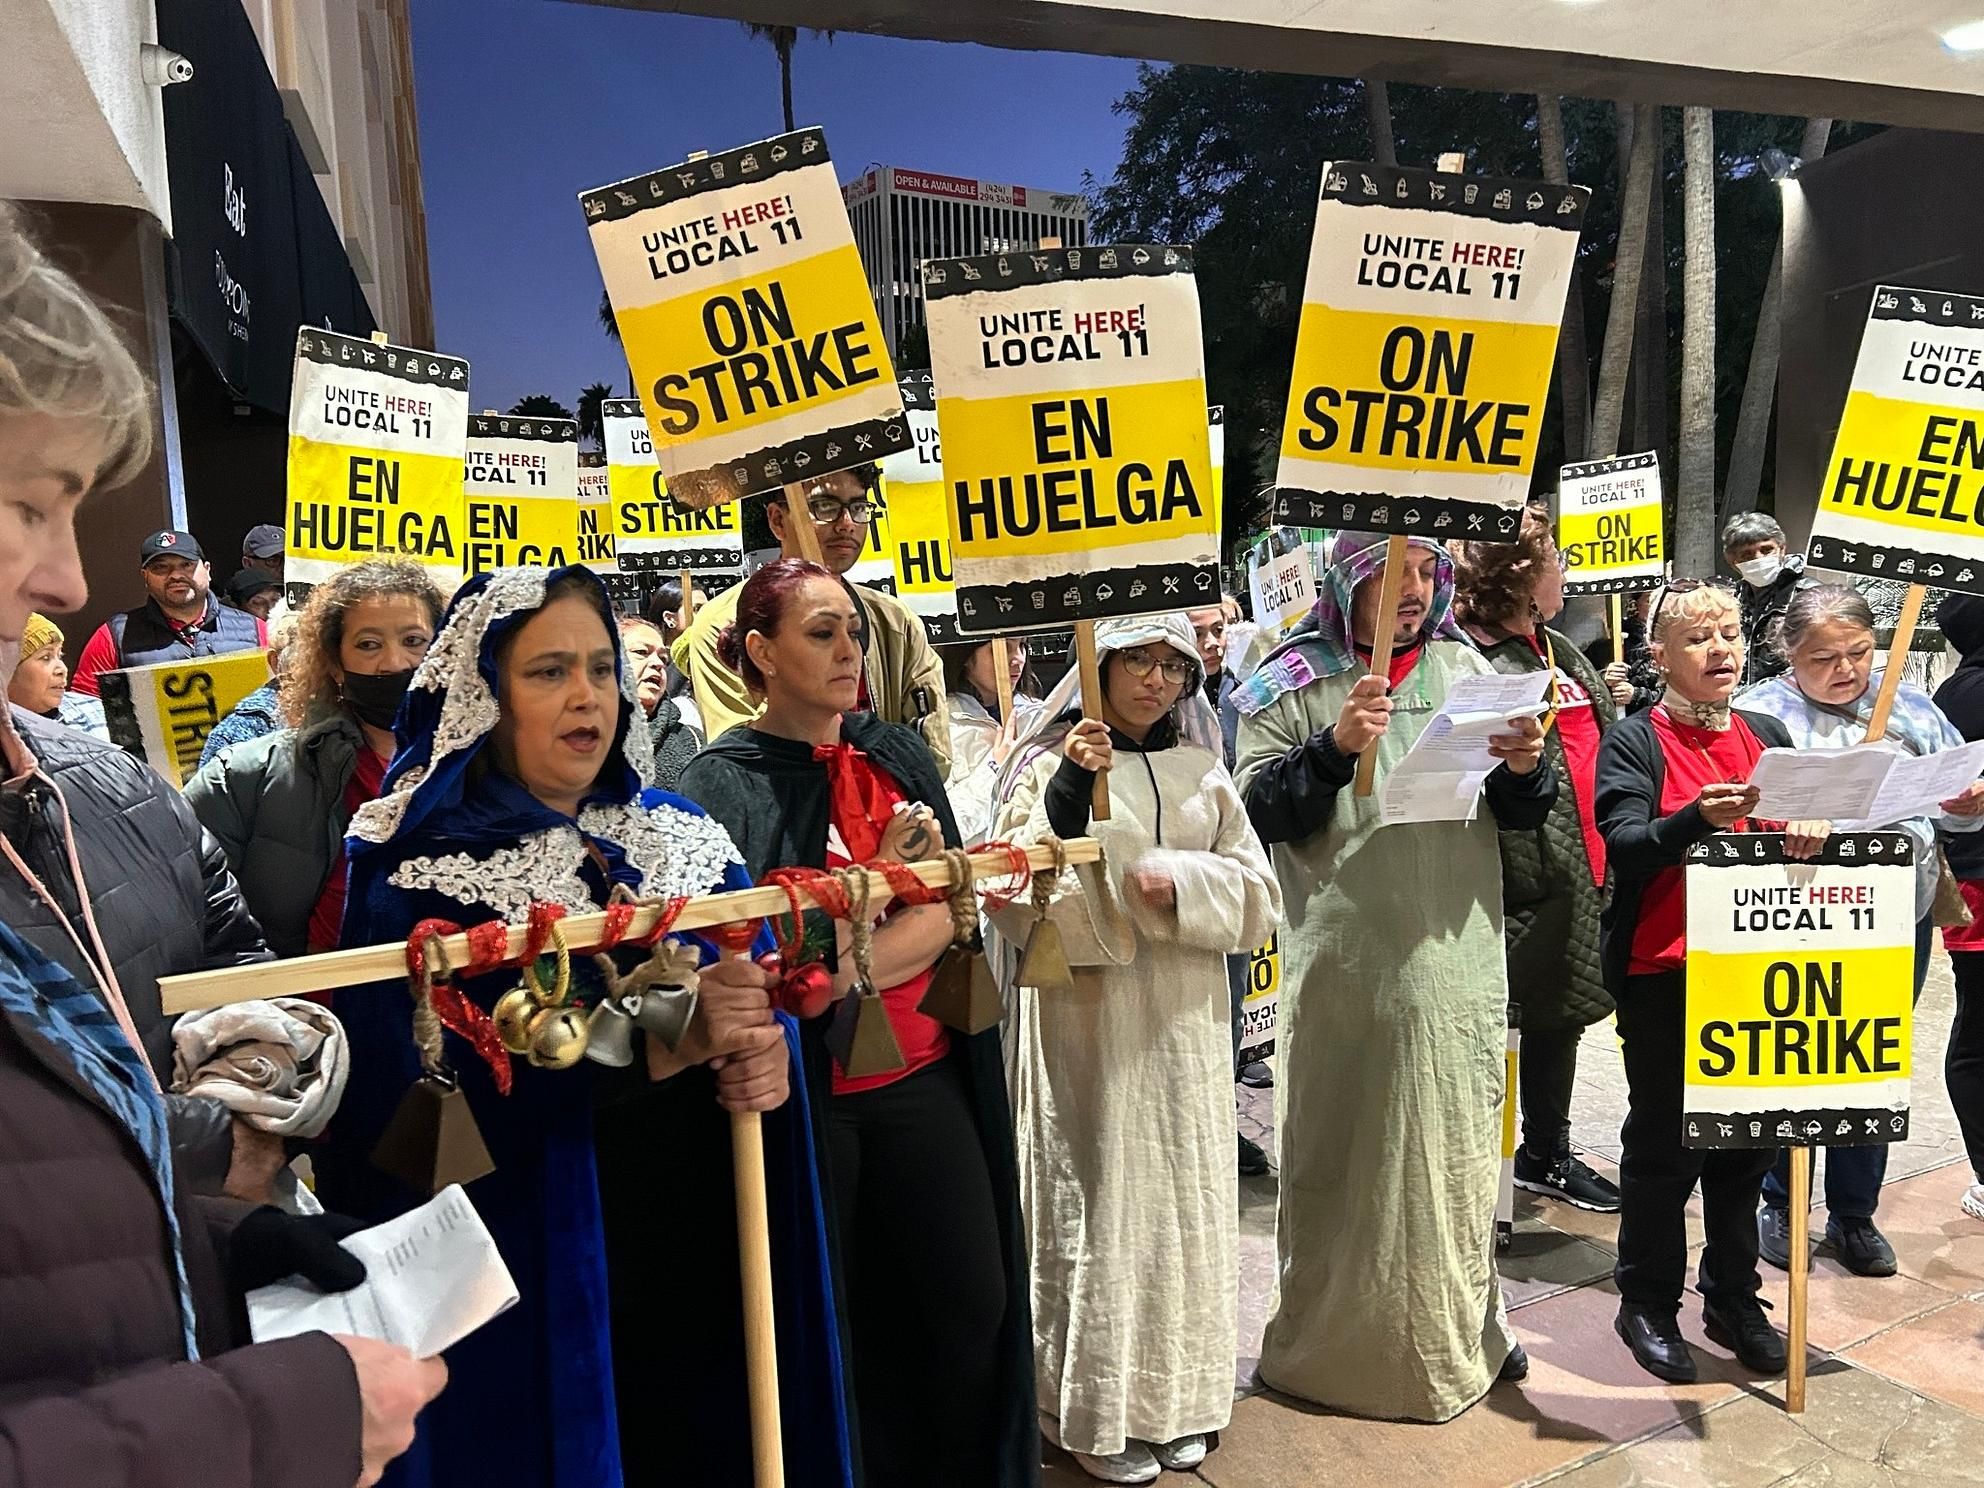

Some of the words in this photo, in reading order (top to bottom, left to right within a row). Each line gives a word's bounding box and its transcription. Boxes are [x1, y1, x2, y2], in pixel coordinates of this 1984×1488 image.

[225, 162, 246, 237] Eat
[895, 174, 921, 188] OPEN
[922, 179, 930, 189] &
[931, 180, 976, 196] AVAILABLE
[642, 216, 718, 253] UNITE
[722, 195, 796, 231] HERE!
[648, 230, 759, 280] LOCAL
[770, 216, 802, 245] 11
[1363, 233, 1444, 261] UNITE
[1452, 242, 1525, 270] HERE!
[1357, 259, 1471, 295] LOCAL
[1492, 272, 1520, 300] 11
[702, 281, 796, 357] ON
[980, 310, 1063, 338] UNITE
[1074, 304, 1146, 334] HERE!
[982, 333, 1101, 368] LOCAL
[1117, 330, 1149, 358] 11
[1380, 326, 1474, 396] ON
[1910, 341, 1982, 367] UNITE
[653, 321, 880, 436] STRIKE
[1902, 360, 1984, 391] LOCA
[326, 385, 379, 409] UNITE
[385, 395, 432, 418] HERE!
[324, 404, 399, 434] LOCAL
[412, 418, 432, 438] 11
[1031, 397, 1113, 465] EN
[1299, 386, 1530, 466] STRIKE
[465, 452, 493, 465] ITE
[499, 453, 546, 468] HERE!
[1917, 415, 1984, 471] EN
[349, 456, 400, 505] EN
[464, 466, 516, 484] CAL
[527, 470, 546, 486] 11
[579, 475, 608, 485] HERE!
[596, 485, 609, 496] 11
[1581, 483, 1612, 495] UNITE
[1616, 479, 1645, 490] HERE!
[1832, 457, 1984, 527] HUEL
[955, 459, 1203, 543] HUELGA
[1582, 492, 1627, 505] LOCAL
[1634, 488, 1645, 498] 11
[293, 502, 455, 558] HUELGA
[469, 503, 518, 540] EN
[577, 509, 598, 535] N
[1596, 513, 1631, 540] ON
[577, 534, 616, 561] RIK
[1566, 534, 1659, 567] STRIKE
[1263, 586, 1292, 613] LOCAL
[1294, 579, 1304, 598] 11
[1733, 888, 1801, 906] UNITE
[1809, 886, 1874, 905] HERE!
[1733, 908, 1832, 931] LOCAL
[1849, 908, 1874, 930] 11
[1764, 961, 1842, 1018] ON
[1698, 1017, 1901, 1077] STRIKE
